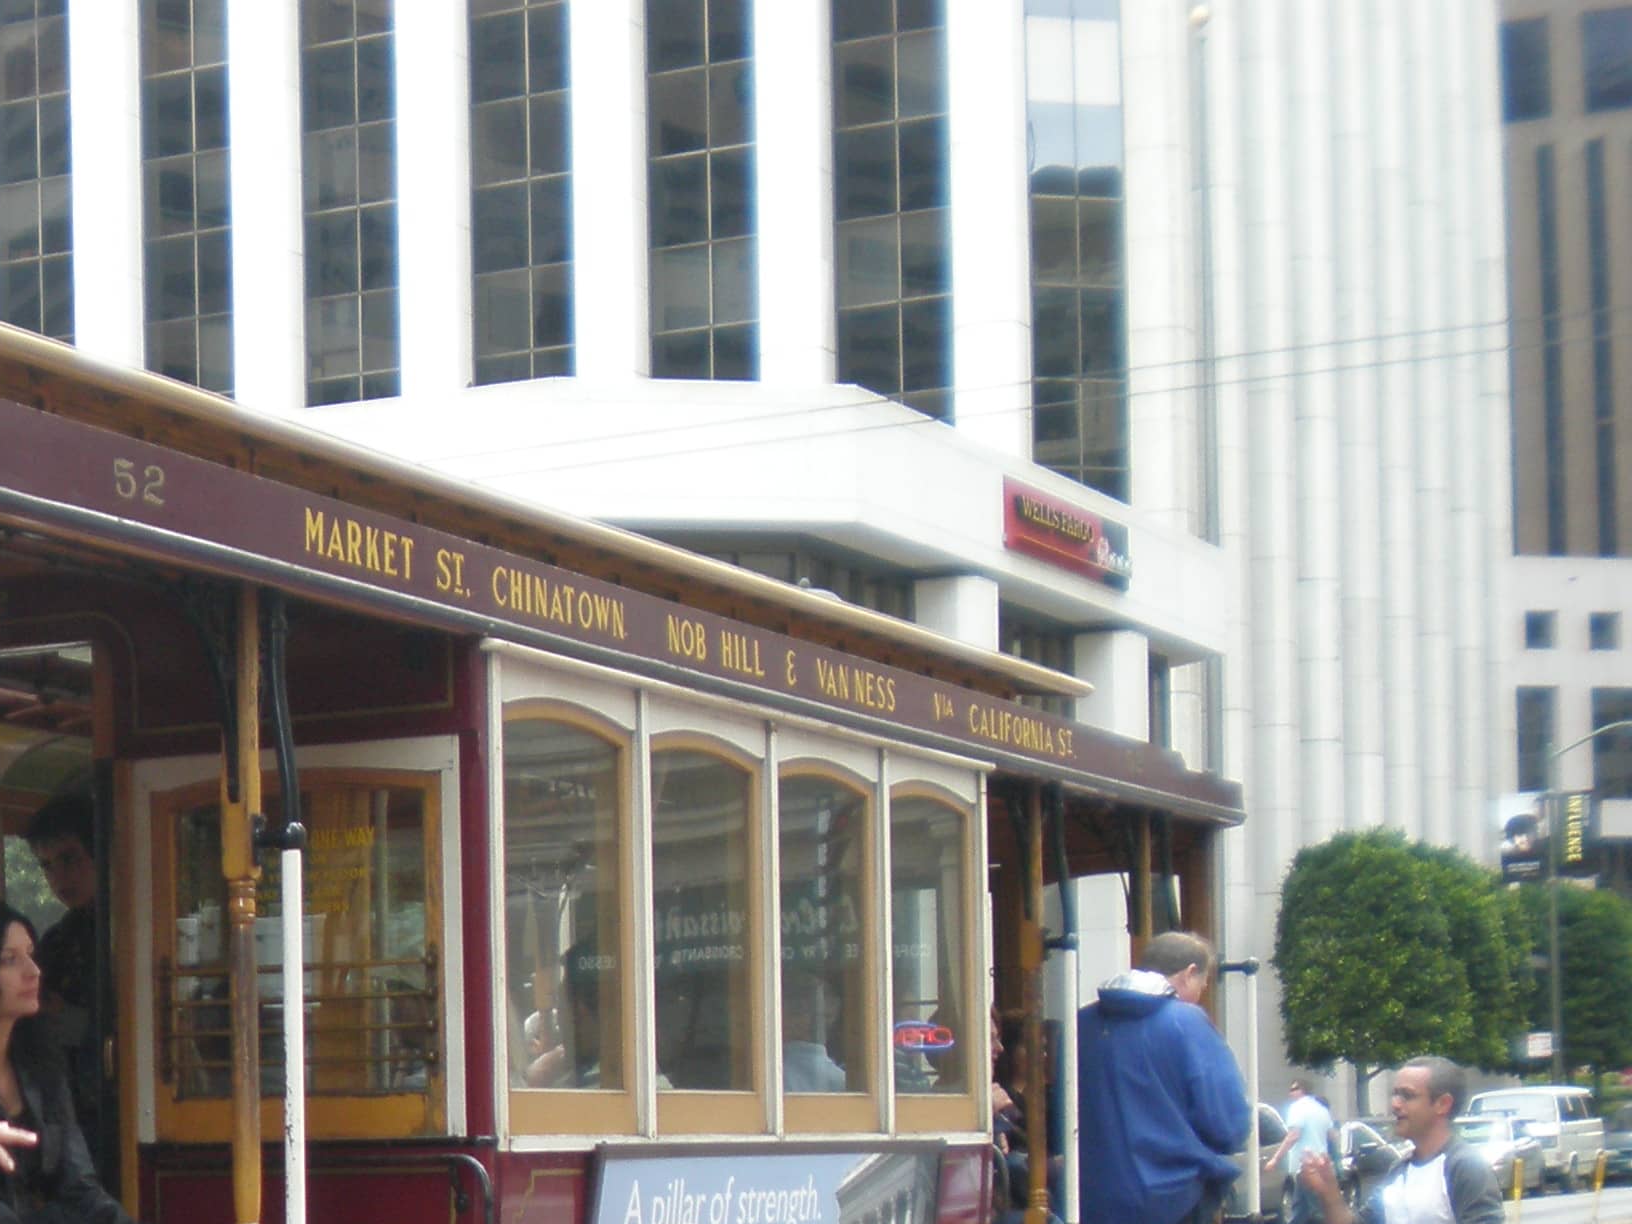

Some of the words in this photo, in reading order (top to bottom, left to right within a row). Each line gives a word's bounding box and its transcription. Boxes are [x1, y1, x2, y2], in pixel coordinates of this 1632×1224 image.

[113, 457, 165, 505] 52
[1021, 495, 1059, 529] WELLS
[1060, 510, 1095, 542] FARGO
[305, 507, 414, 580] MARKET
[668, 613, 707, 661] NOB
[721, 630, 765, 678] HILL
[816, 659, 849, 700] VAN
[854, 670, 896, 712] NESS
[969, 703, 1054, 754] CALIFORNIA
